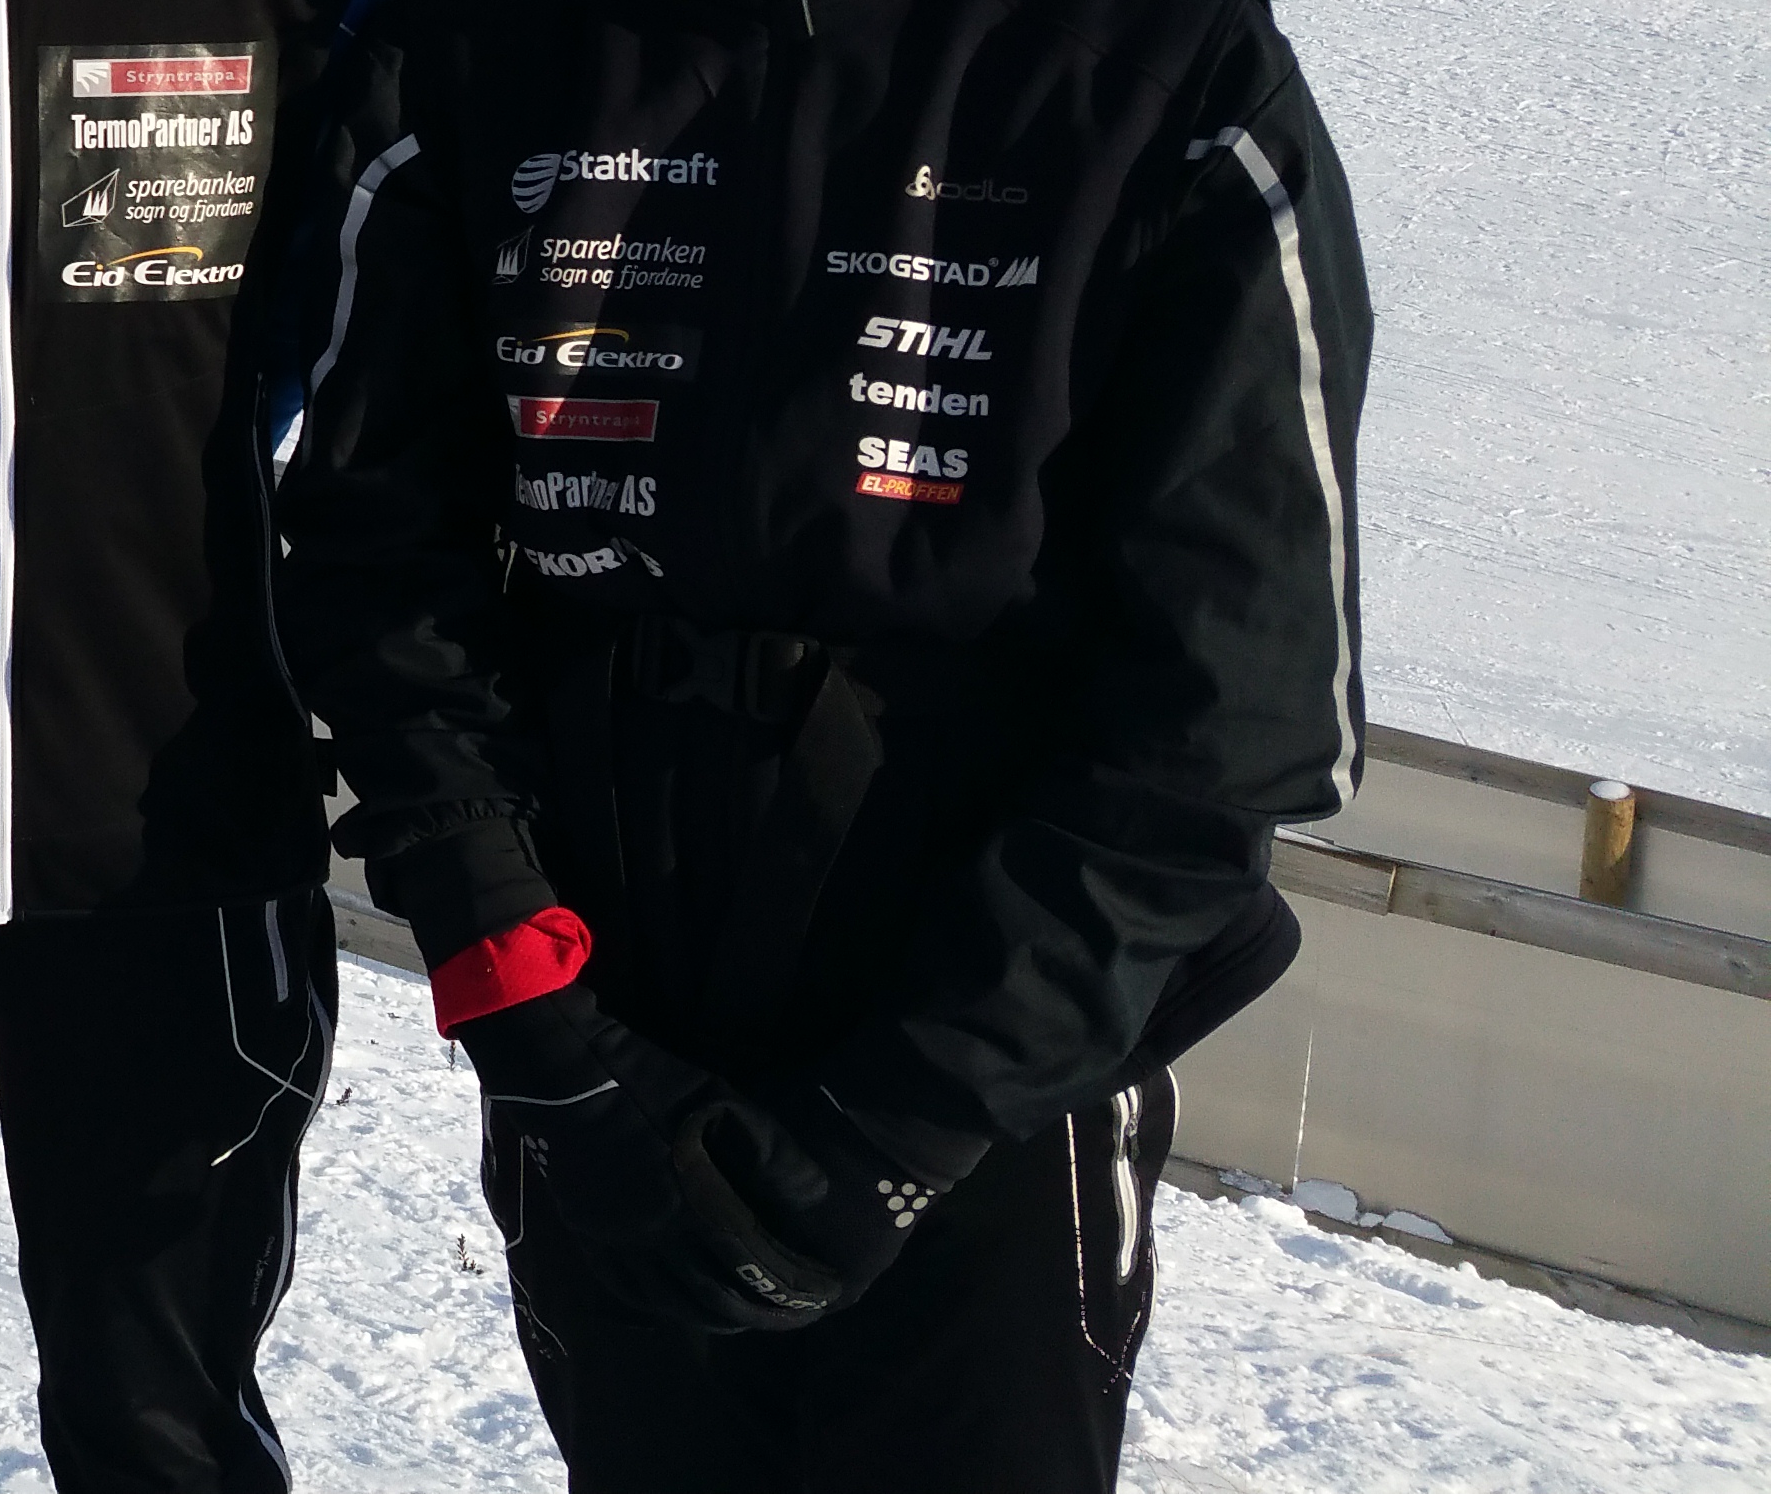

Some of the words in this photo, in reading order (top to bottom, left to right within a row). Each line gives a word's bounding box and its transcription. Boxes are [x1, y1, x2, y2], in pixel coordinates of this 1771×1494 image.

[126, 70, 236, 85] Stryntrappa
[71, 112, 222, 150] TermoPartner
[226, 109, 254, 146] AS
[559, 149, 719, 186] Statkraft
[126, 171, 255, 201] sparebanken
[937, 179, 1028, 204] odlo
[126, 205, 164, 223] sogn
[169, 205, 190, 221] og
[191, 200, 254, 223] fjordane
[540, 233, 706, 265] sparebanken
[62, 261, 125, 287] Eid
[134, 260, 244, 286] Elektro
[540, 266, 587, 288] sogn
[591, 268, 614, 289] og
[615, 265, 704, 290] fjordane
[827, 251, 990, 286] SKOGSTAD
[496, 336, 546, 364] Eid
[556, 340, 684, 370] Elektro
[857, 316, 992, 360] STIHL
[849, 372, 989, 416] tenden
[857, 436, 969, 478] SEAS
[619, 475, 656, 516] AS
[862, 475, 959, 500] EL-PROFFEN
